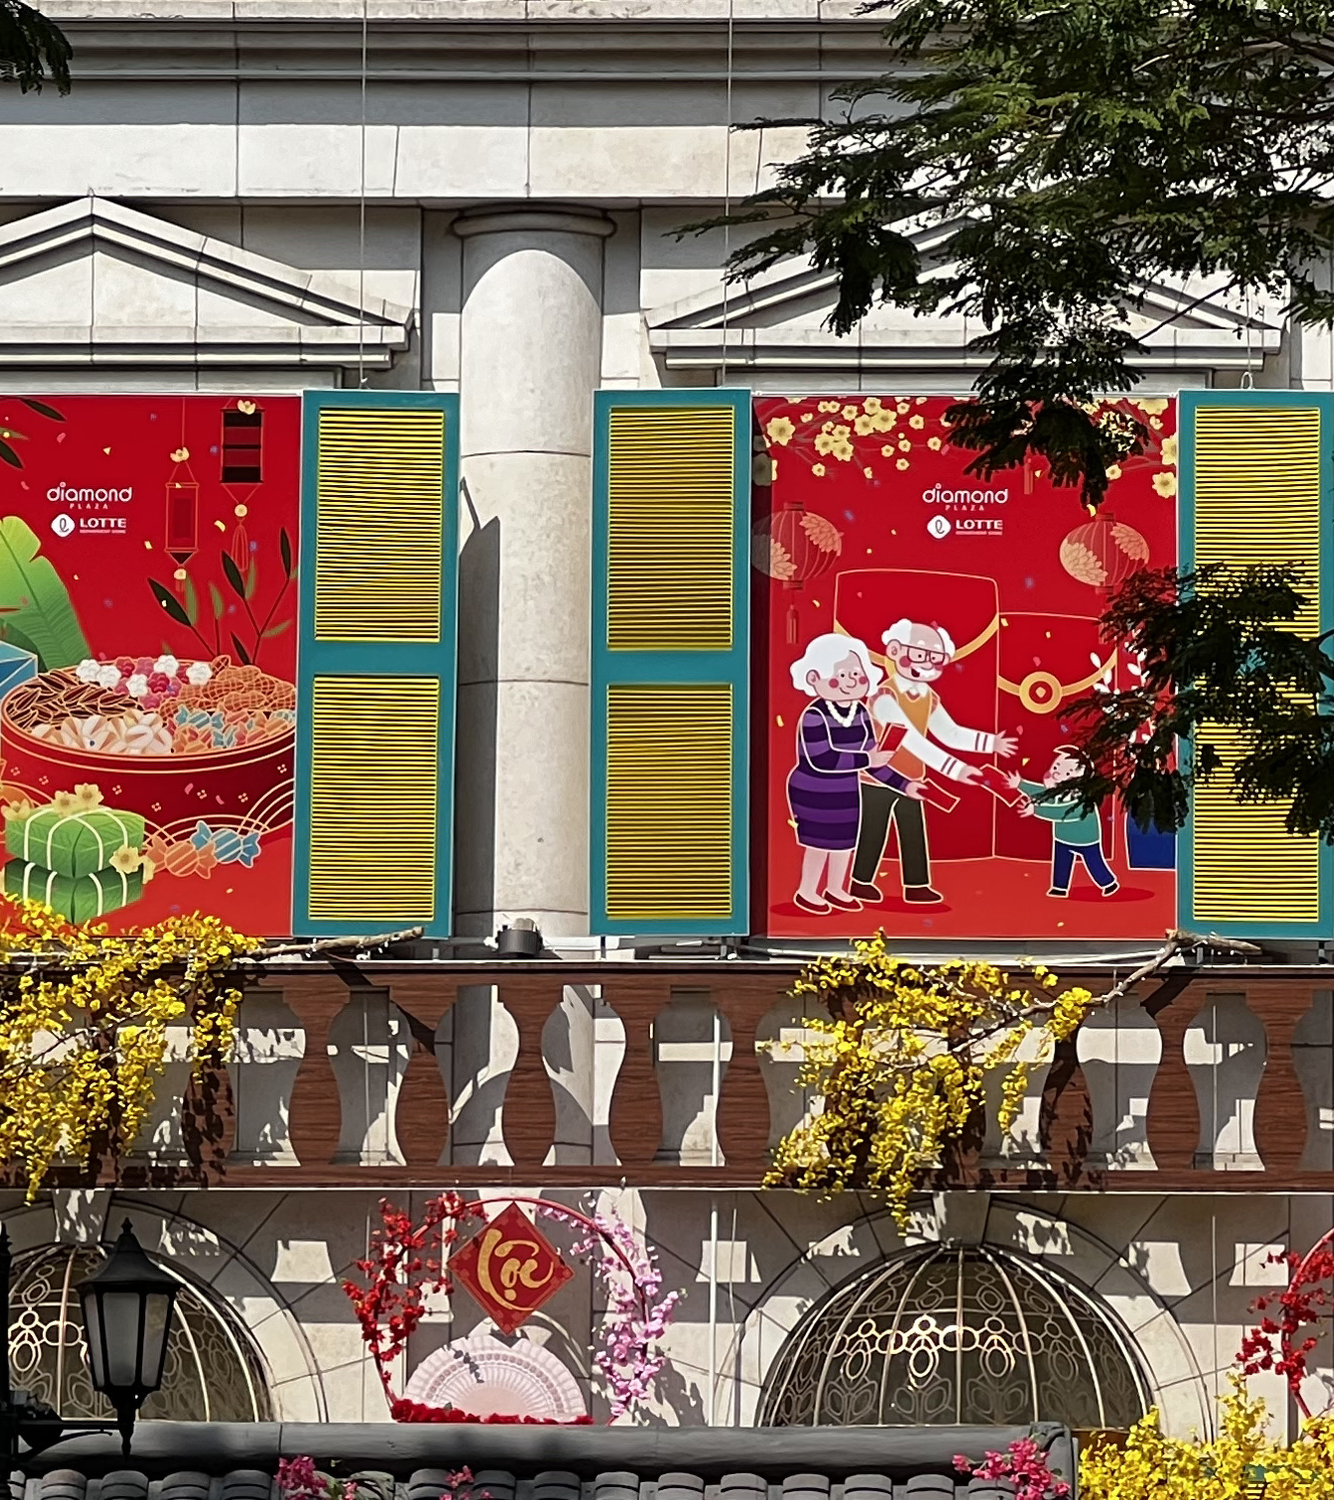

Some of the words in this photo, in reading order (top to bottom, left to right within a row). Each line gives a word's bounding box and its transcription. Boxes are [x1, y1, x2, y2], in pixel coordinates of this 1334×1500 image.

[46, 481, 133, 502] diamond
[922, 482, 1009, 504] diamond
[79, 517, 127, 528] LOTTE
[955, 519, 1004, 530] LOTTE
